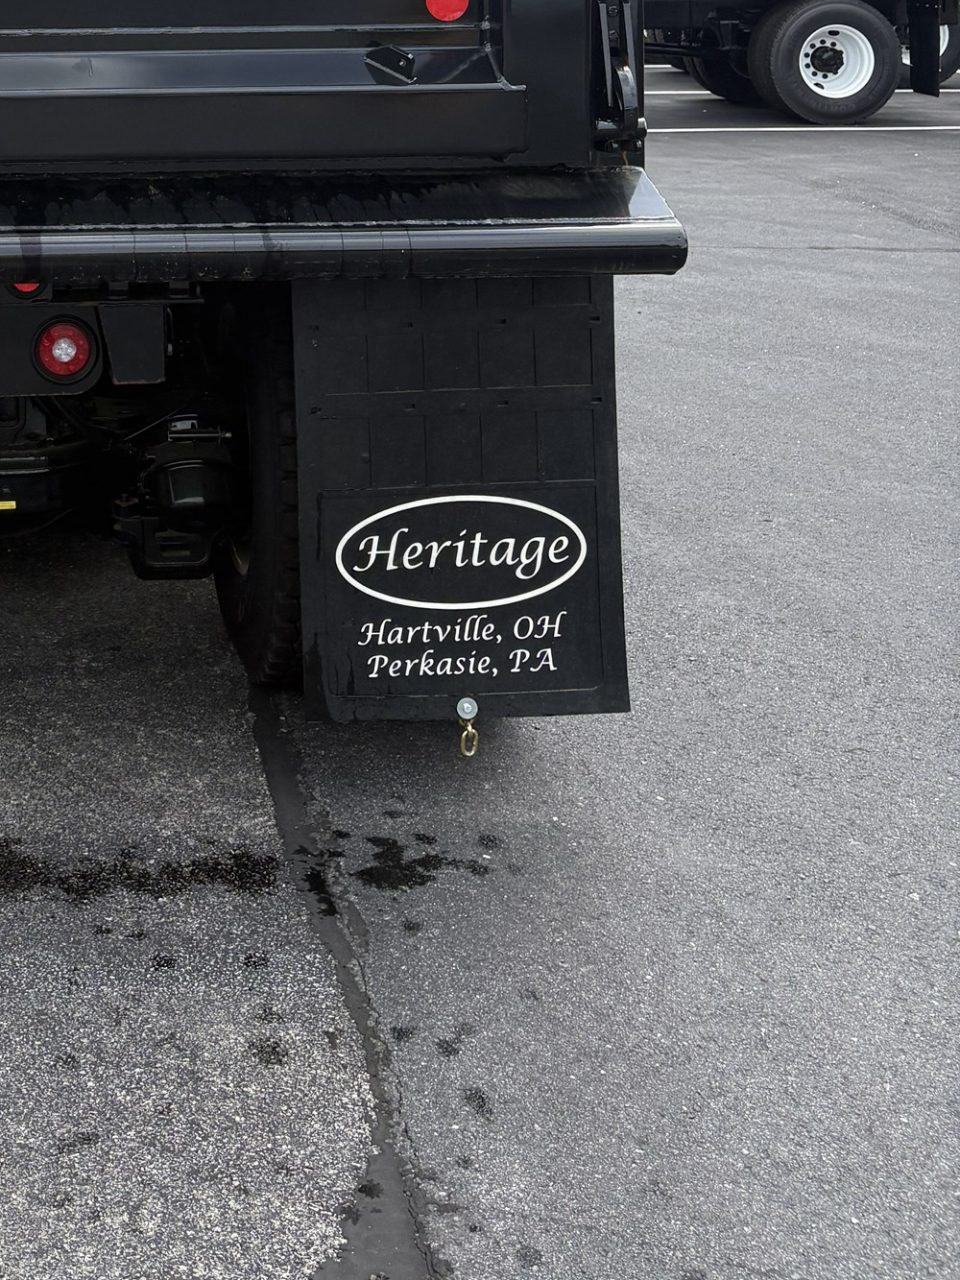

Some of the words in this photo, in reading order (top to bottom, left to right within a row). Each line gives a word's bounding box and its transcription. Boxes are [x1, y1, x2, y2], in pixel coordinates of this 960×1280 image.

[352, 528, 570, 580] Heritage
[357, 614, 503, 646] Hartville,
[512, 611, 567, 640] OH
[366, 649, 499, 679] Perkasie,
[508, 647, 558, 673] PA
